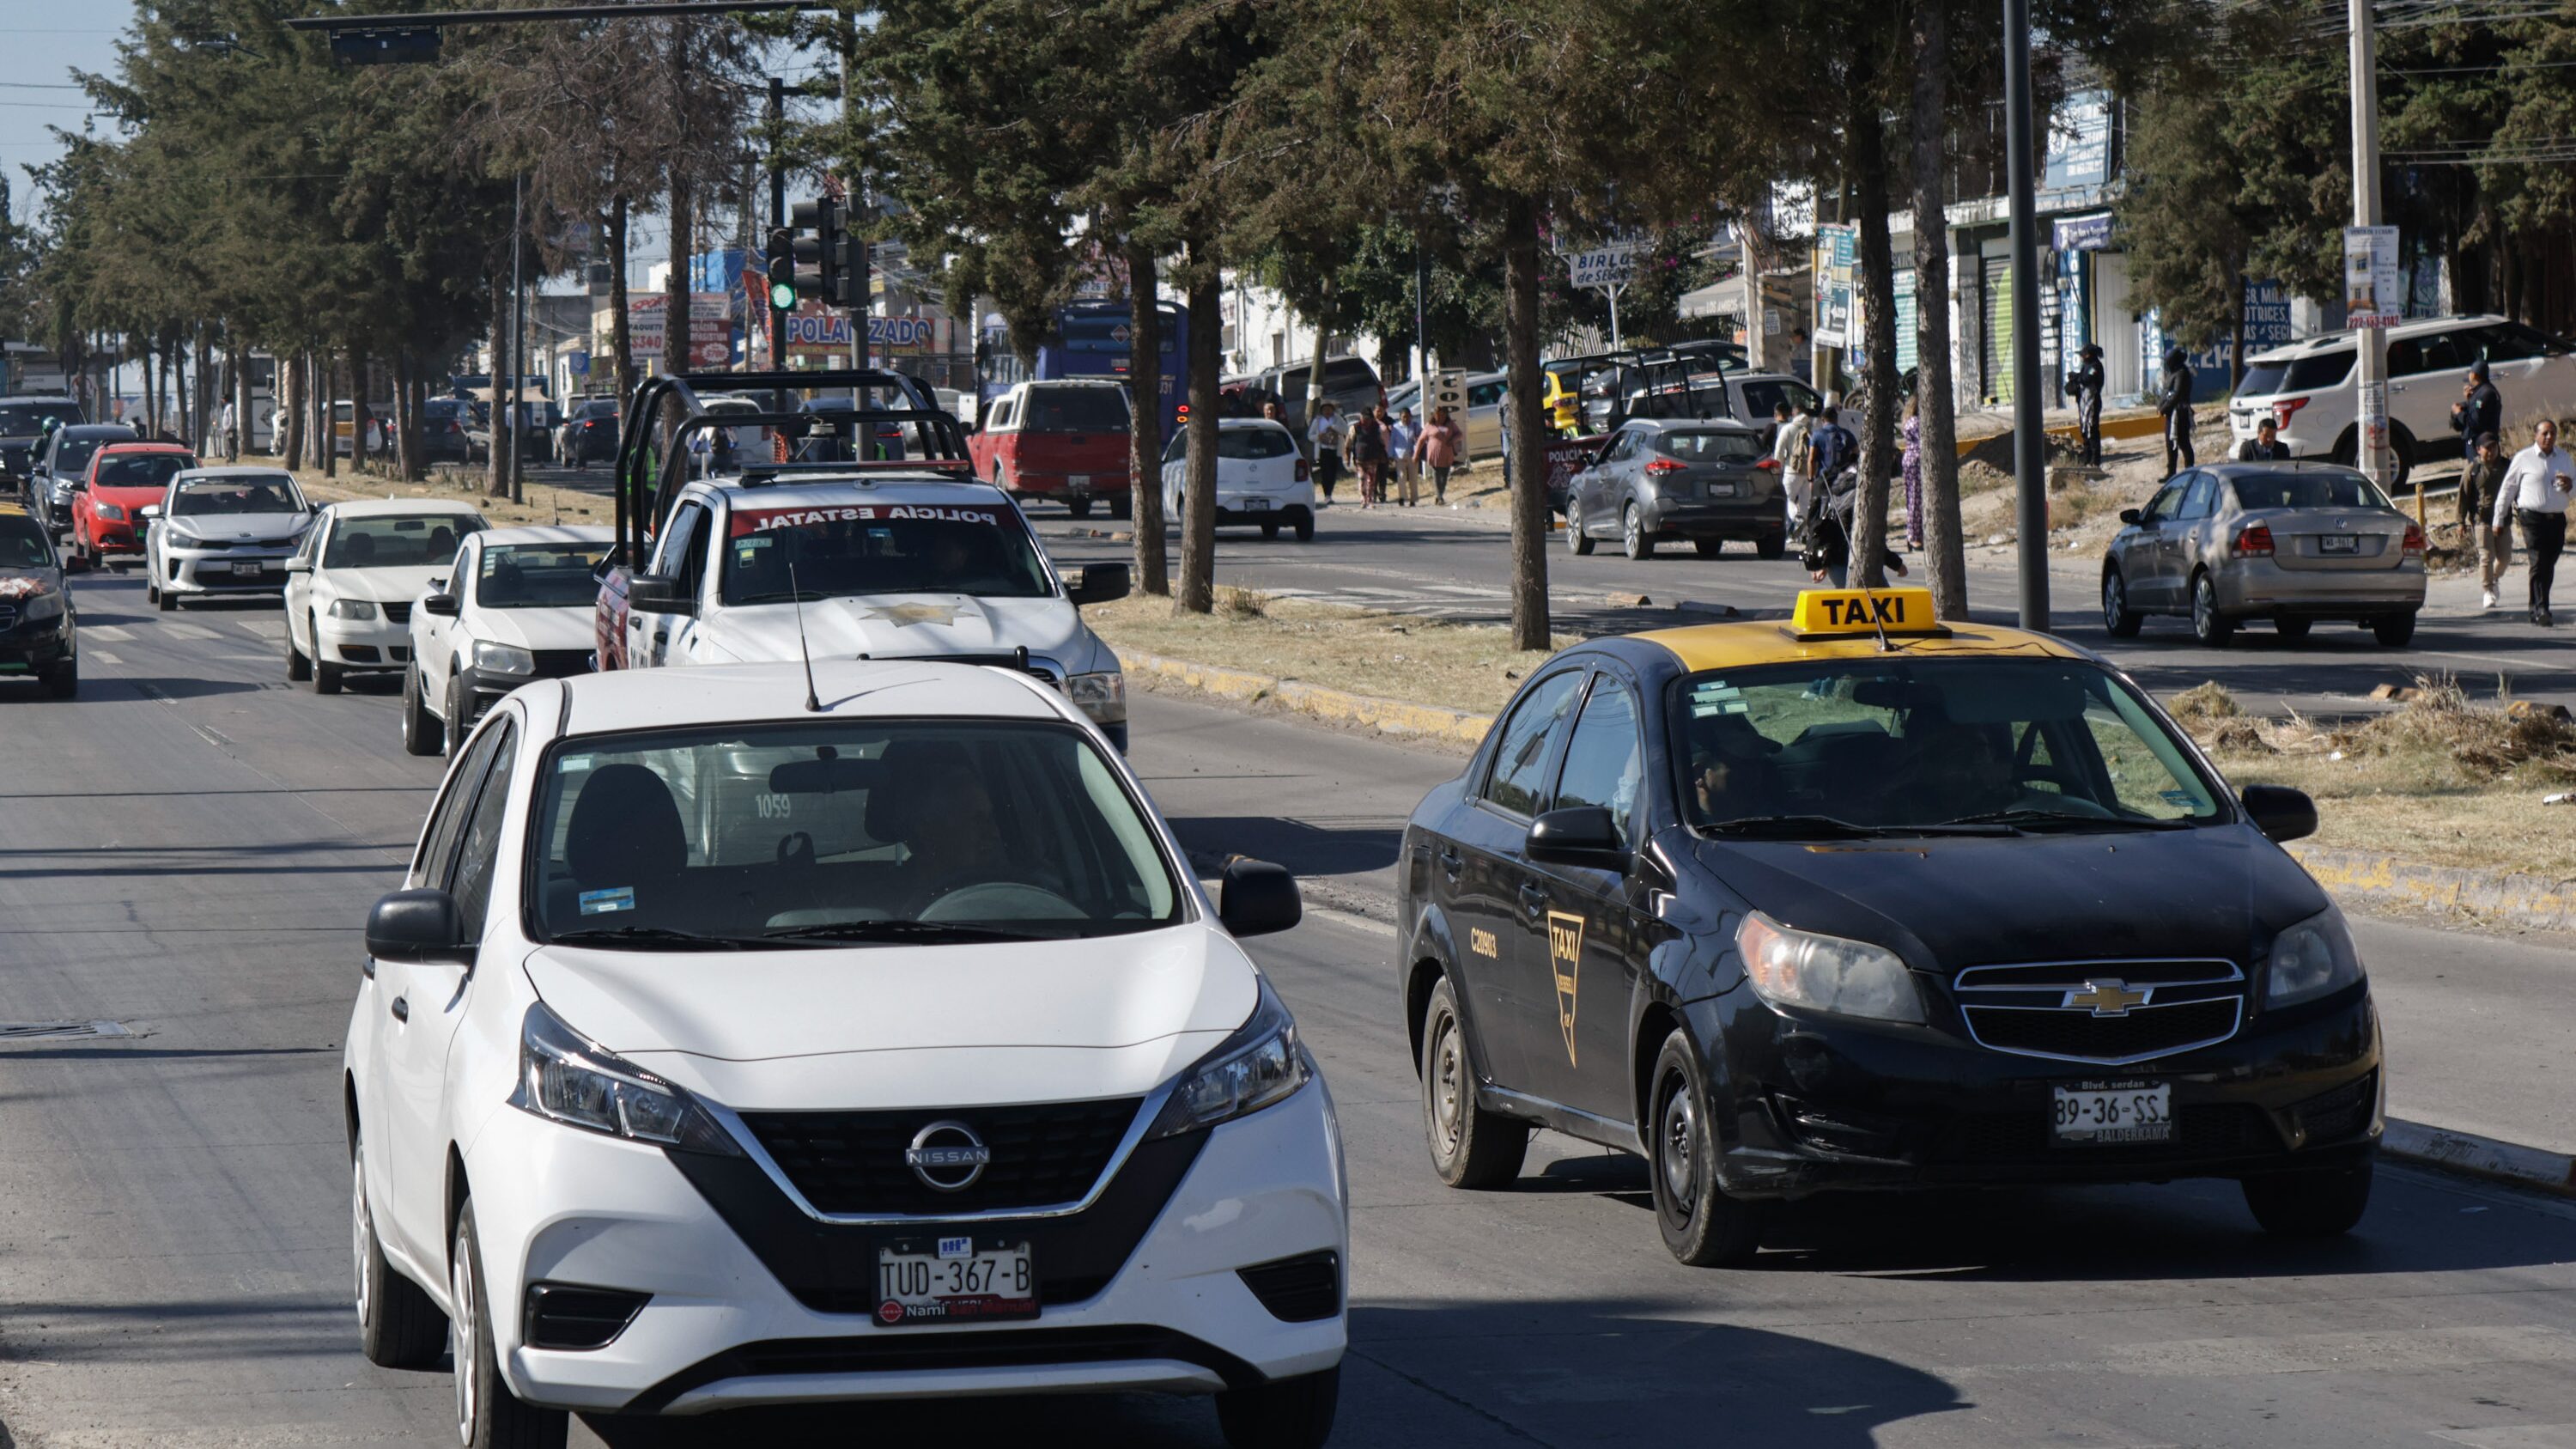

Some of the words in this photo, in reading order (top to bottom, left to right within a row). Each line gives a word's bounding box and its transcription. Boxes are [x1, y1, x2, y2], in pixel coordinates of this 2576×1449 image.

[786, 316, 932, 344] POLAZADO
[1821, 597, 1905, 625] TAXI
[755, 794, 791, 819] 1059
[1471, 927, 1497, 959] C20903
[1552, 926, 1576, 962] TAXI
[2081, 1081, 2108, 1090] Blvd.
[2111, 1080, 2145, 1089] serdan
[2096, 1128, 2170, 1142] BALDERRAMA
[909, 1150, 988, 1164] NISSAN
[880, 1257, 1031, 1297] TUD-367-B
[906, 1305, 945, 1318] Nami
